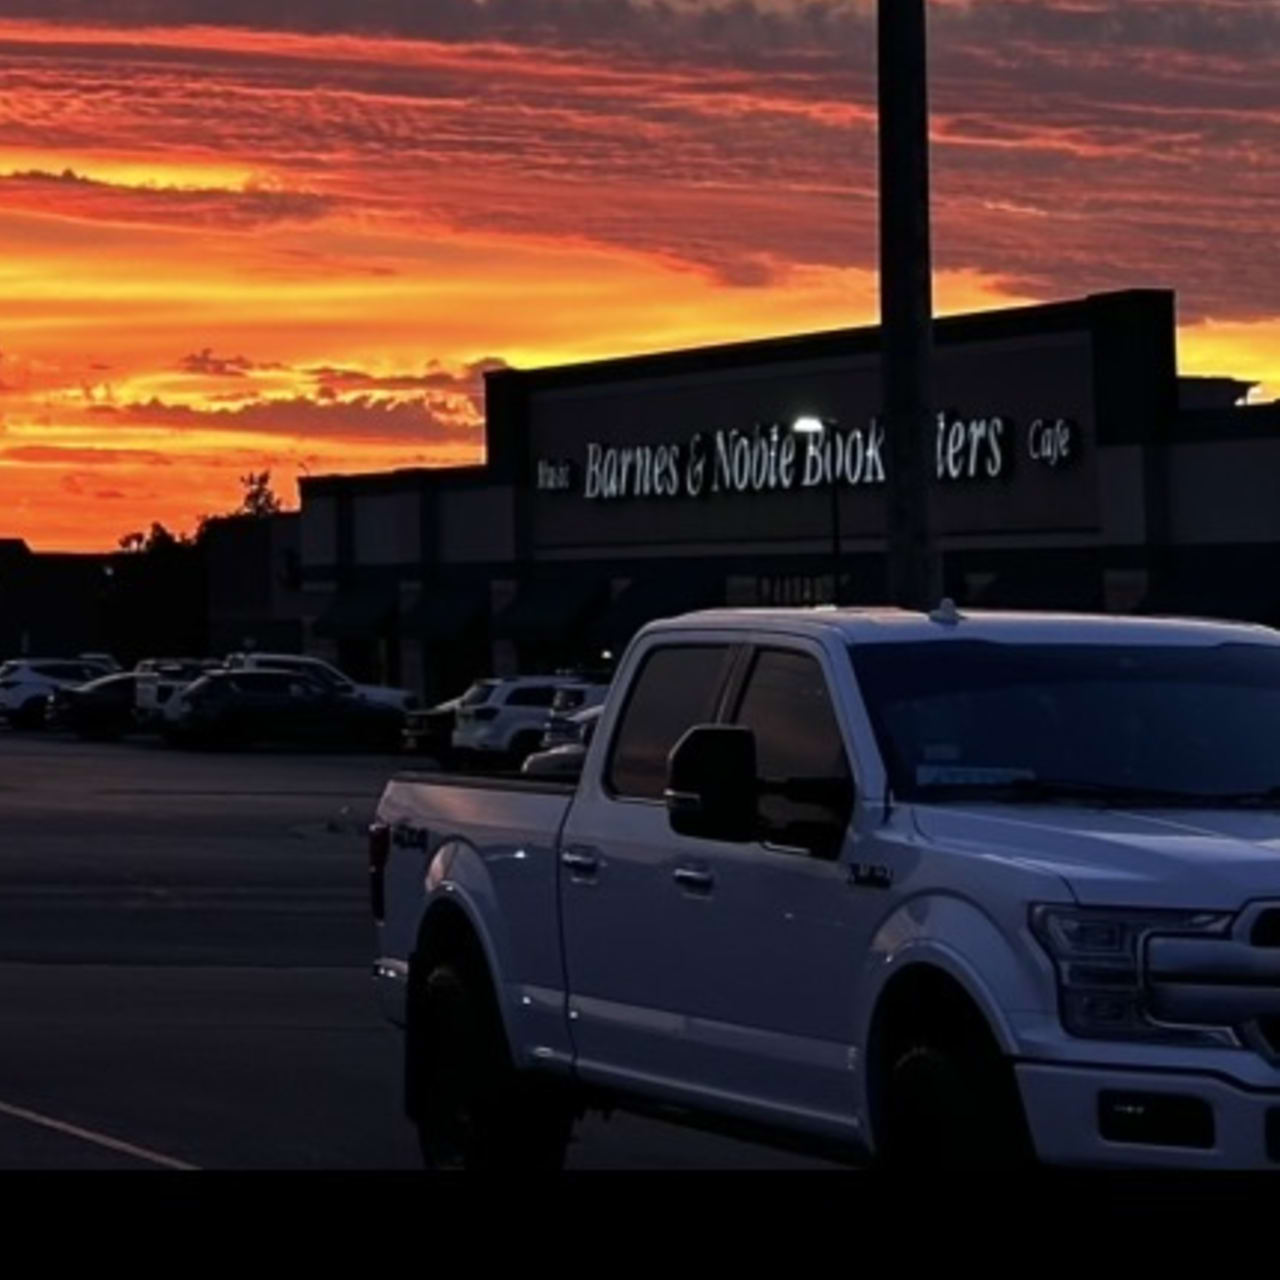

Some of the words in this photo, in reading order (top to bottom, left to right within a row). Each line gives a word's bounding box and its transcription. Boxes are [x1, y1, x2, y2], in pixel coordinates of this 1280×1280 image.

[584, 441, 680, 499] Barnes
[686, 432, 707, 497] &
[711, 422, 796, 492] Noble
[1027, 418, 1071, 467] Cafe
